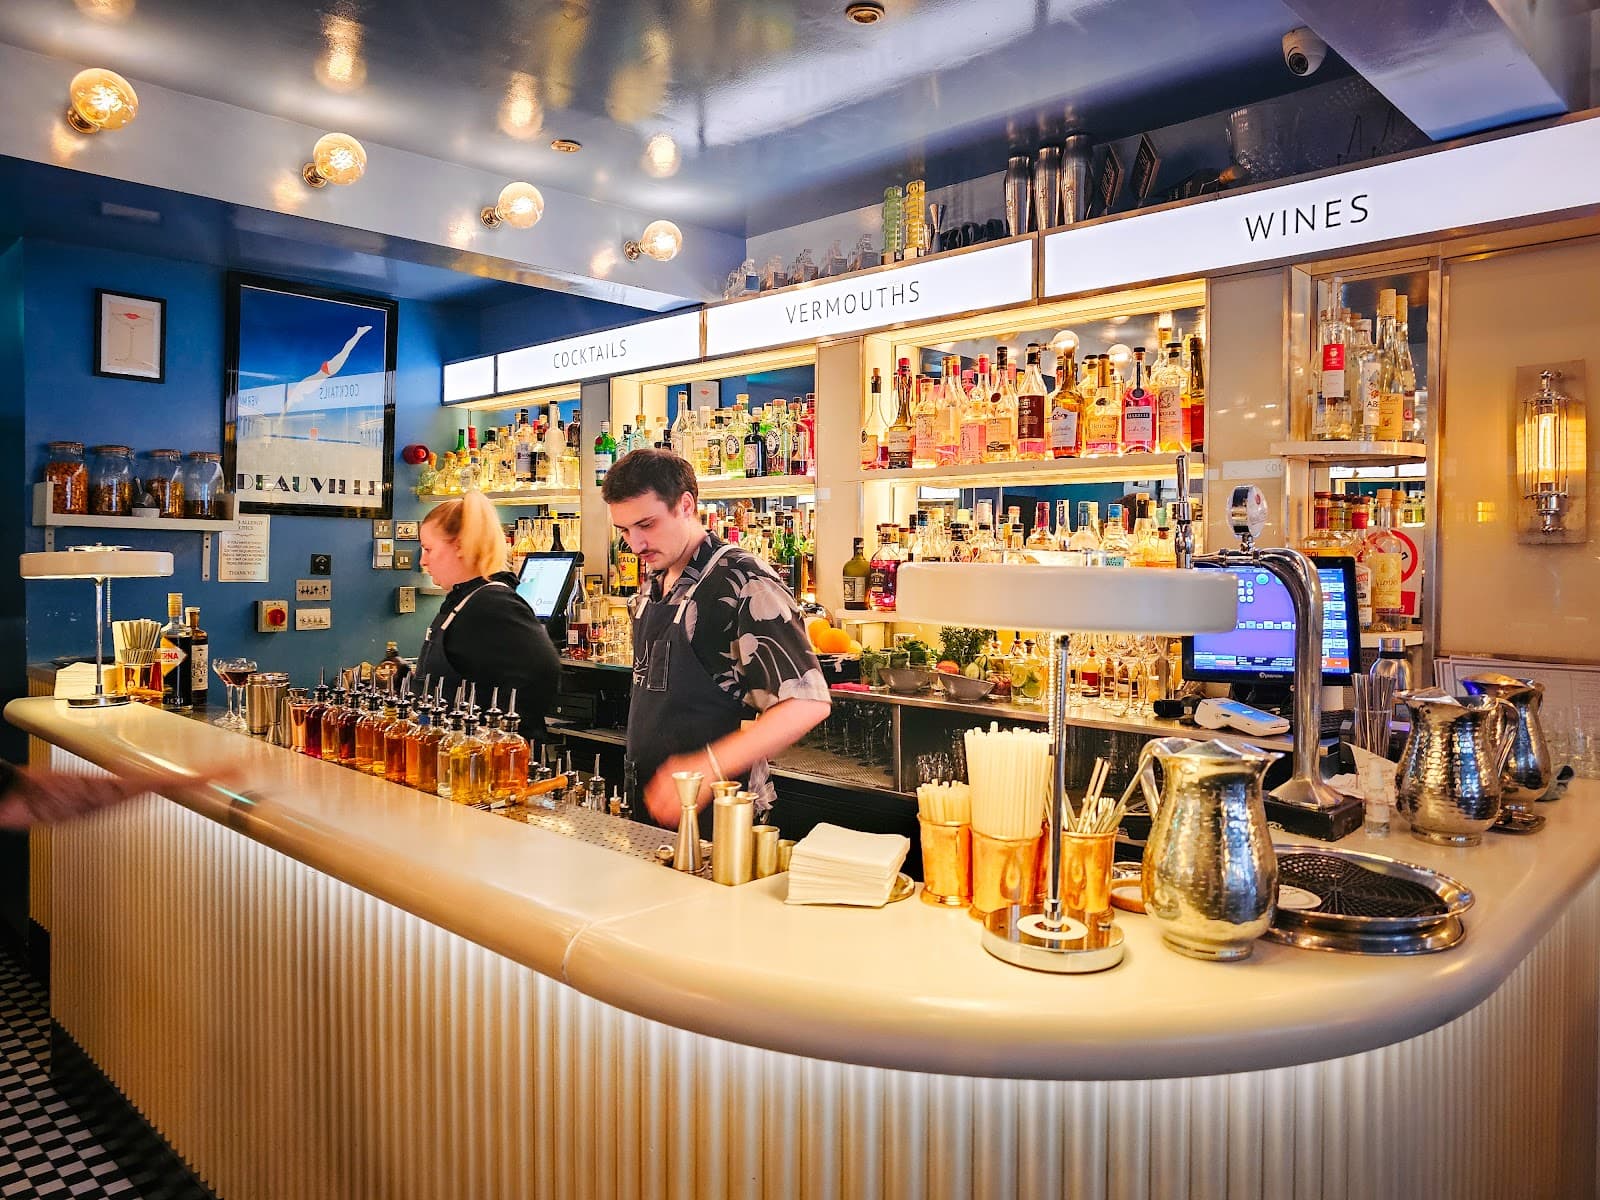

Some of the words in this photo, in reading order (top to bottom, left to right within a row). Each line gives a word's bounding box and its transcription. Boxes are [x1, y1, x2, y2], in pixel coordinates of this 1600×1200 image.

[1245, 194, 1368, 242] WINES
[785, 280, 920, 324] VERMOUTHS
[553, 339, 627, 369] COCKTAILS
[236, 473, 382, 496] DEAUVILLE
